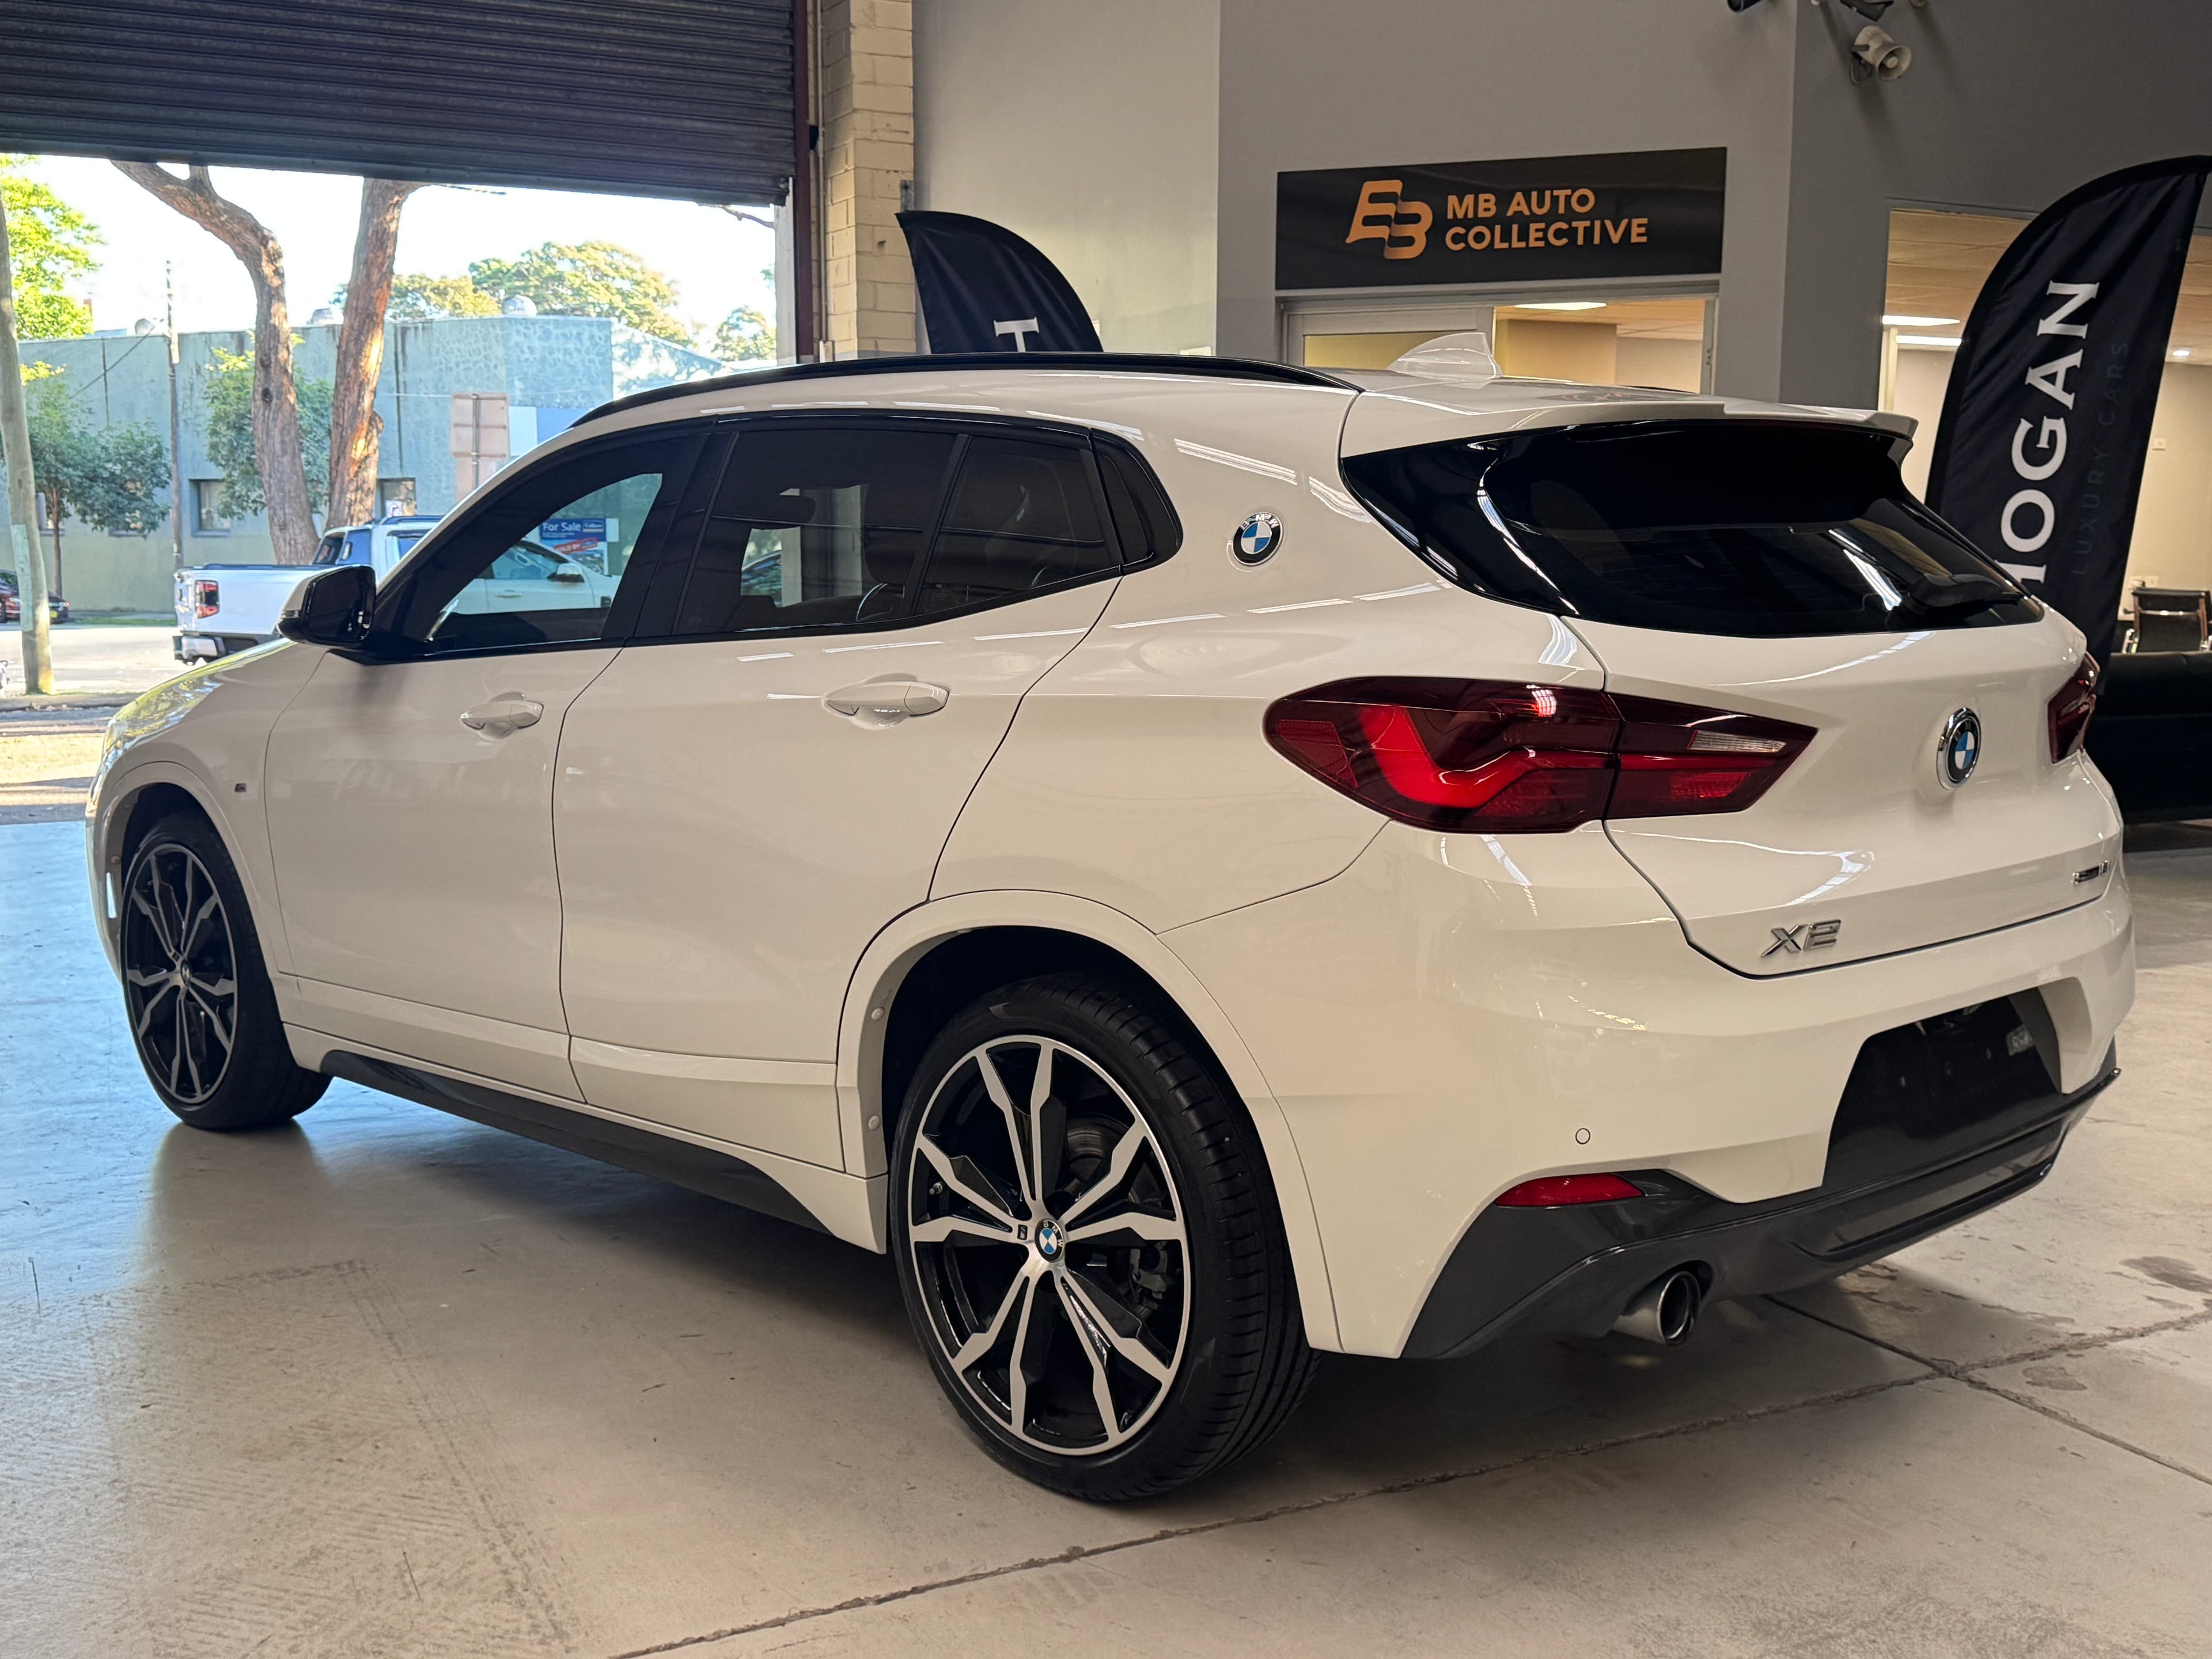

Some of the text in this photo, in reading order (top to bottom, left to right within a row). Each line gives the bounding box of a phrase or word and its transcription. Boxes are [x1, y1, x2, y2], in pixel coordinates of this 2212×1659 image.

[1446, 188, 1596, 219] MB AUTO
[1445, 218, 1648, 251] COLLECTIVE
[2070, 342, 2130, 575] LUXURY CARS
[543, 522, 559, 531] For
[561, 522, 581, 532] Sale
[1760, 919, 1842, 957] X2
[1043, 1220, 1065, 1248] BMW
